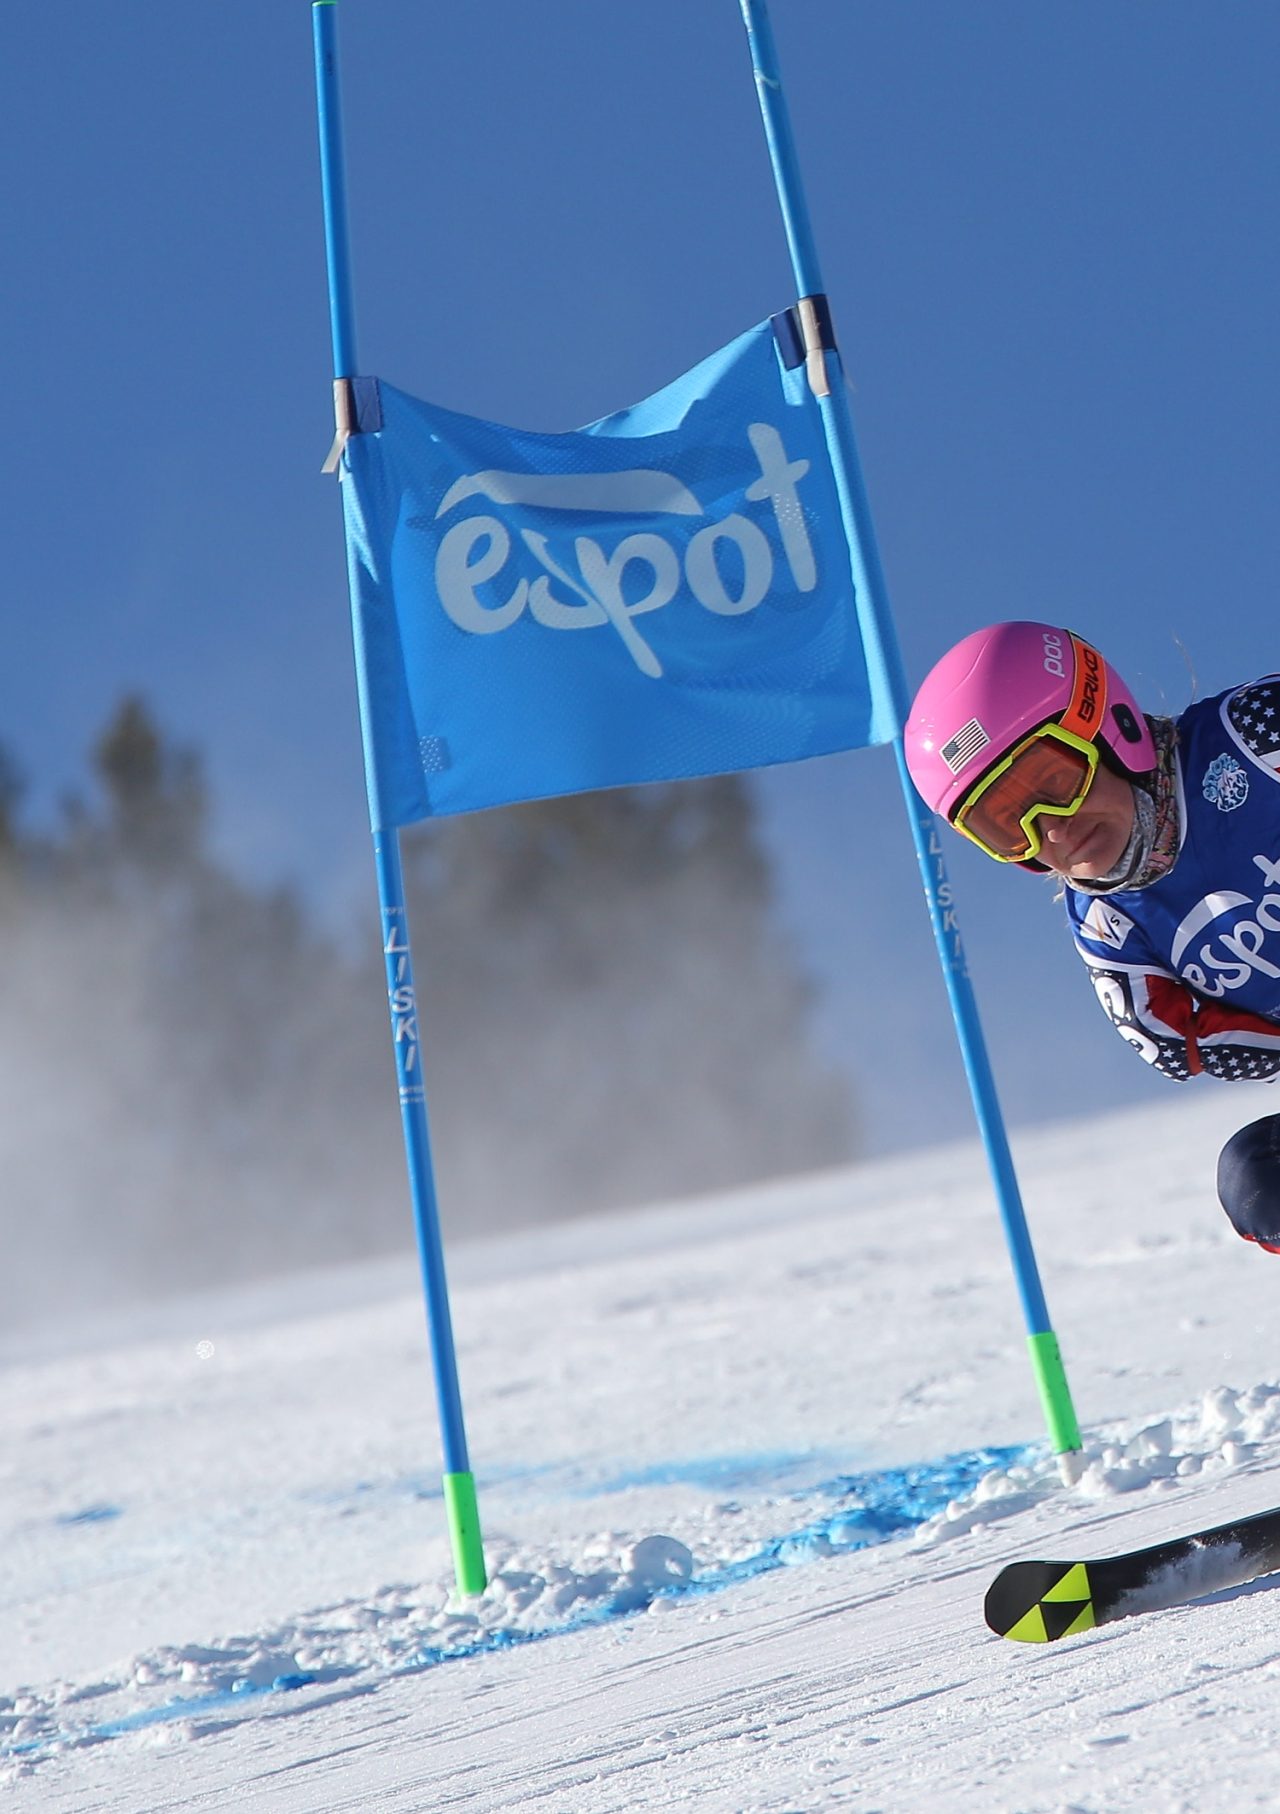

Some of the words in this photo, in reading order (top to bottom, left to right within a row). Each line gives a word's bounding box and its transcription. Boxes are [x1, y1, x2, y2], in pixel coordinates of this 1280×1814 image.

[435, 423, 817, 678] espot
[1077, 648, 1099, 723] BRIKO
[929, 830, 961, 957] LISKI
[384, 926, 416, 1073] LISKI
